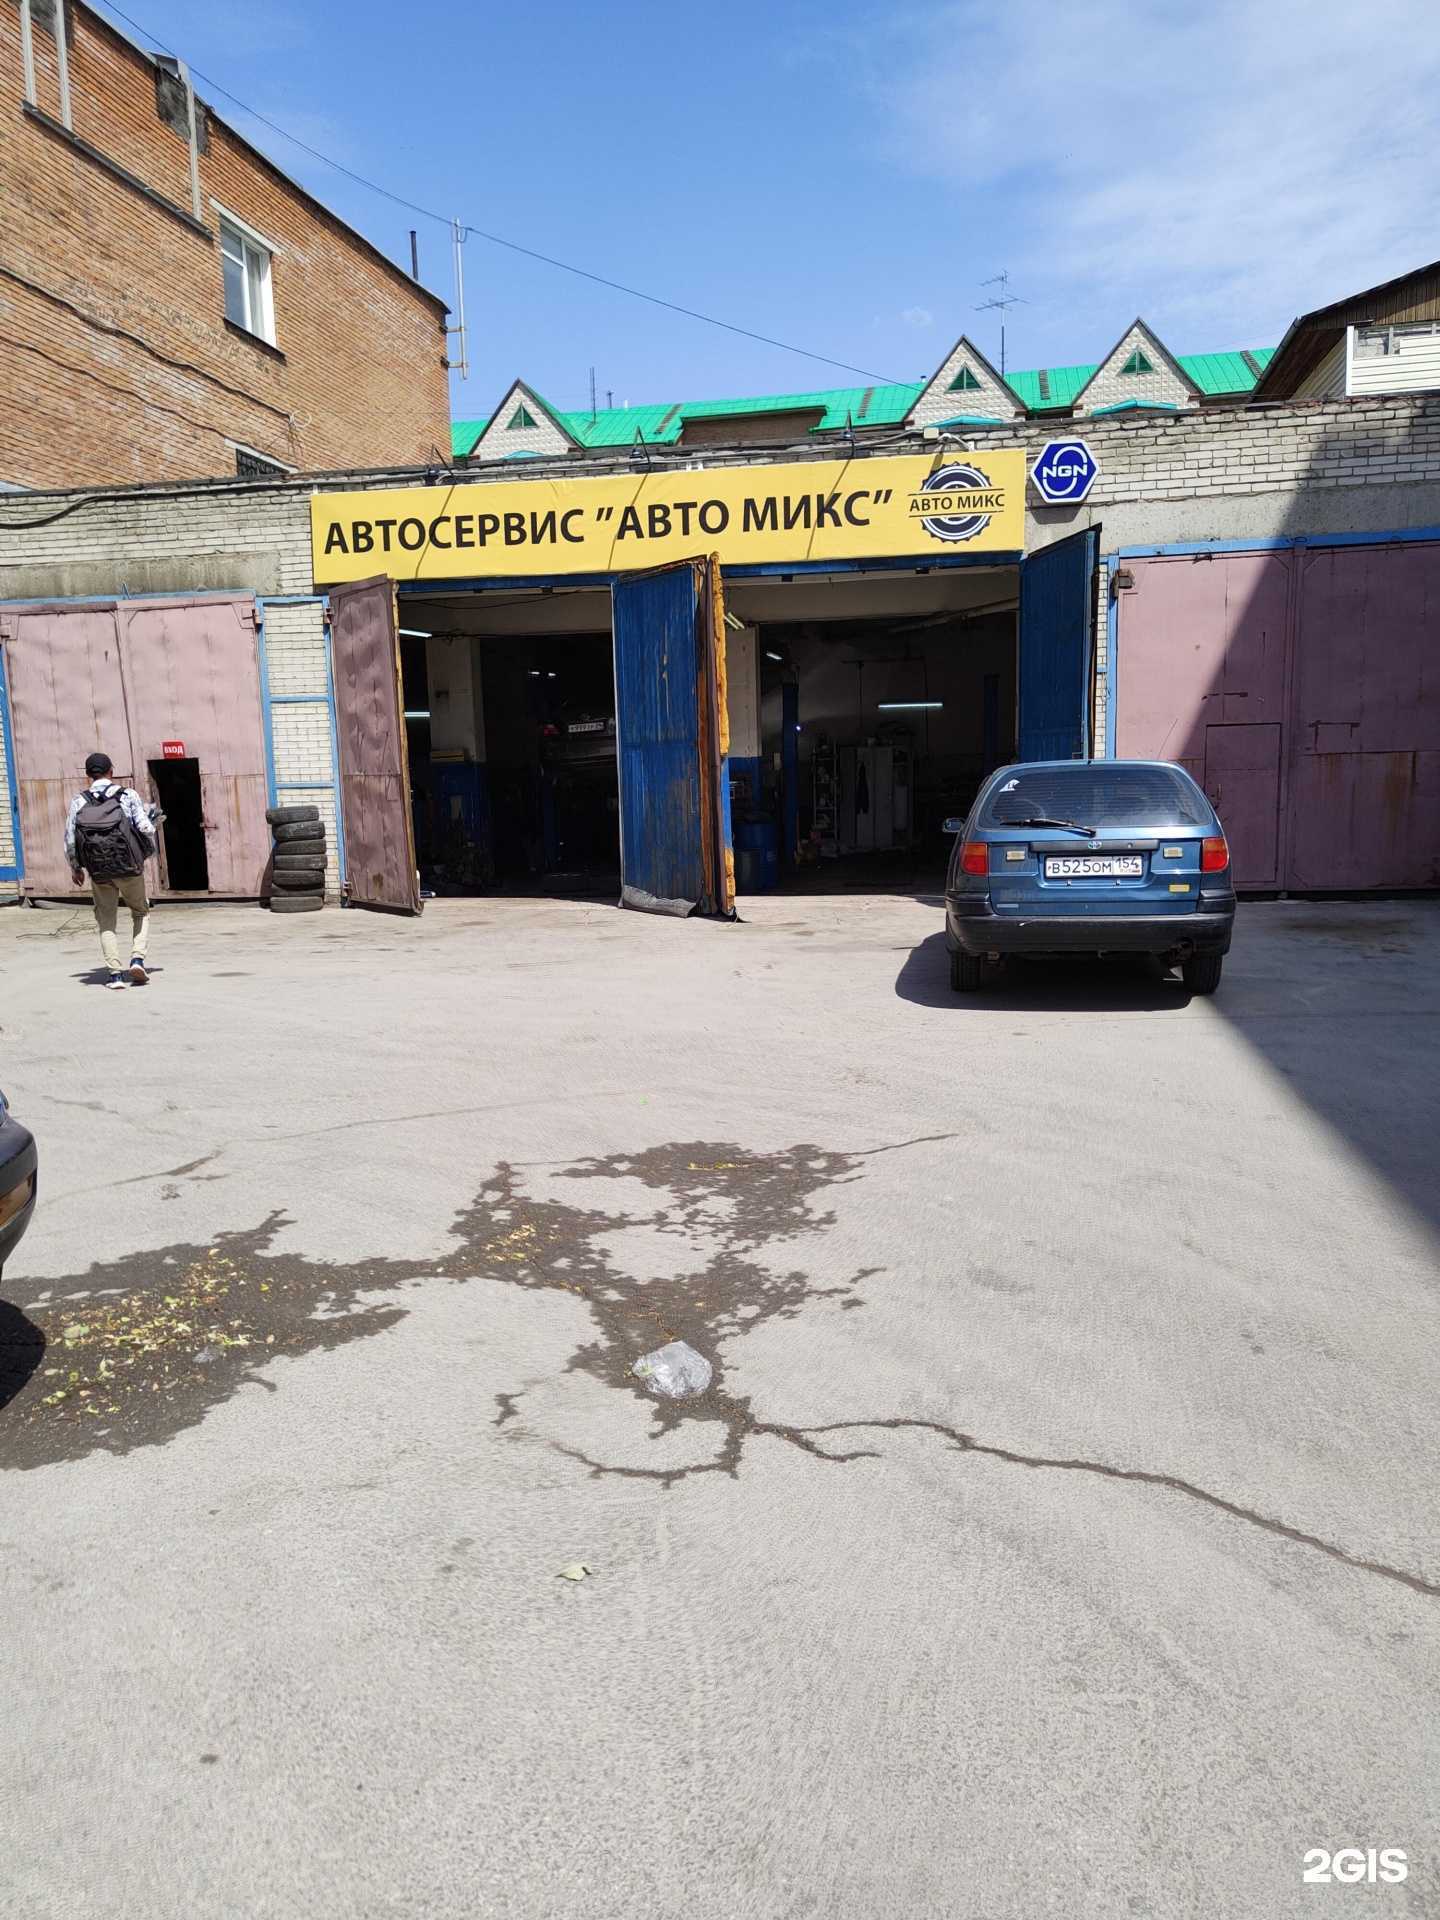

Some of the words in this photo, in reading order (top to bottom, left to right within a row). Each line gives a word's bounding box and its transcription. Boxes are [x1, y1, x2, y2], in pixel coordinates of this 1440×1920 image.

[1042, 465, 1088, 478] NGN
[909, 496, 953, 513] АВТО
[957, 493, 1005, 510] МИКС
[324, 508, 585, 555] АВТОСЕРВИС
[595, 499, 730, 541] "АВТО
[742, 488, 894, 533] МИКС"
[164, 745, 184, 756] ВХОД
